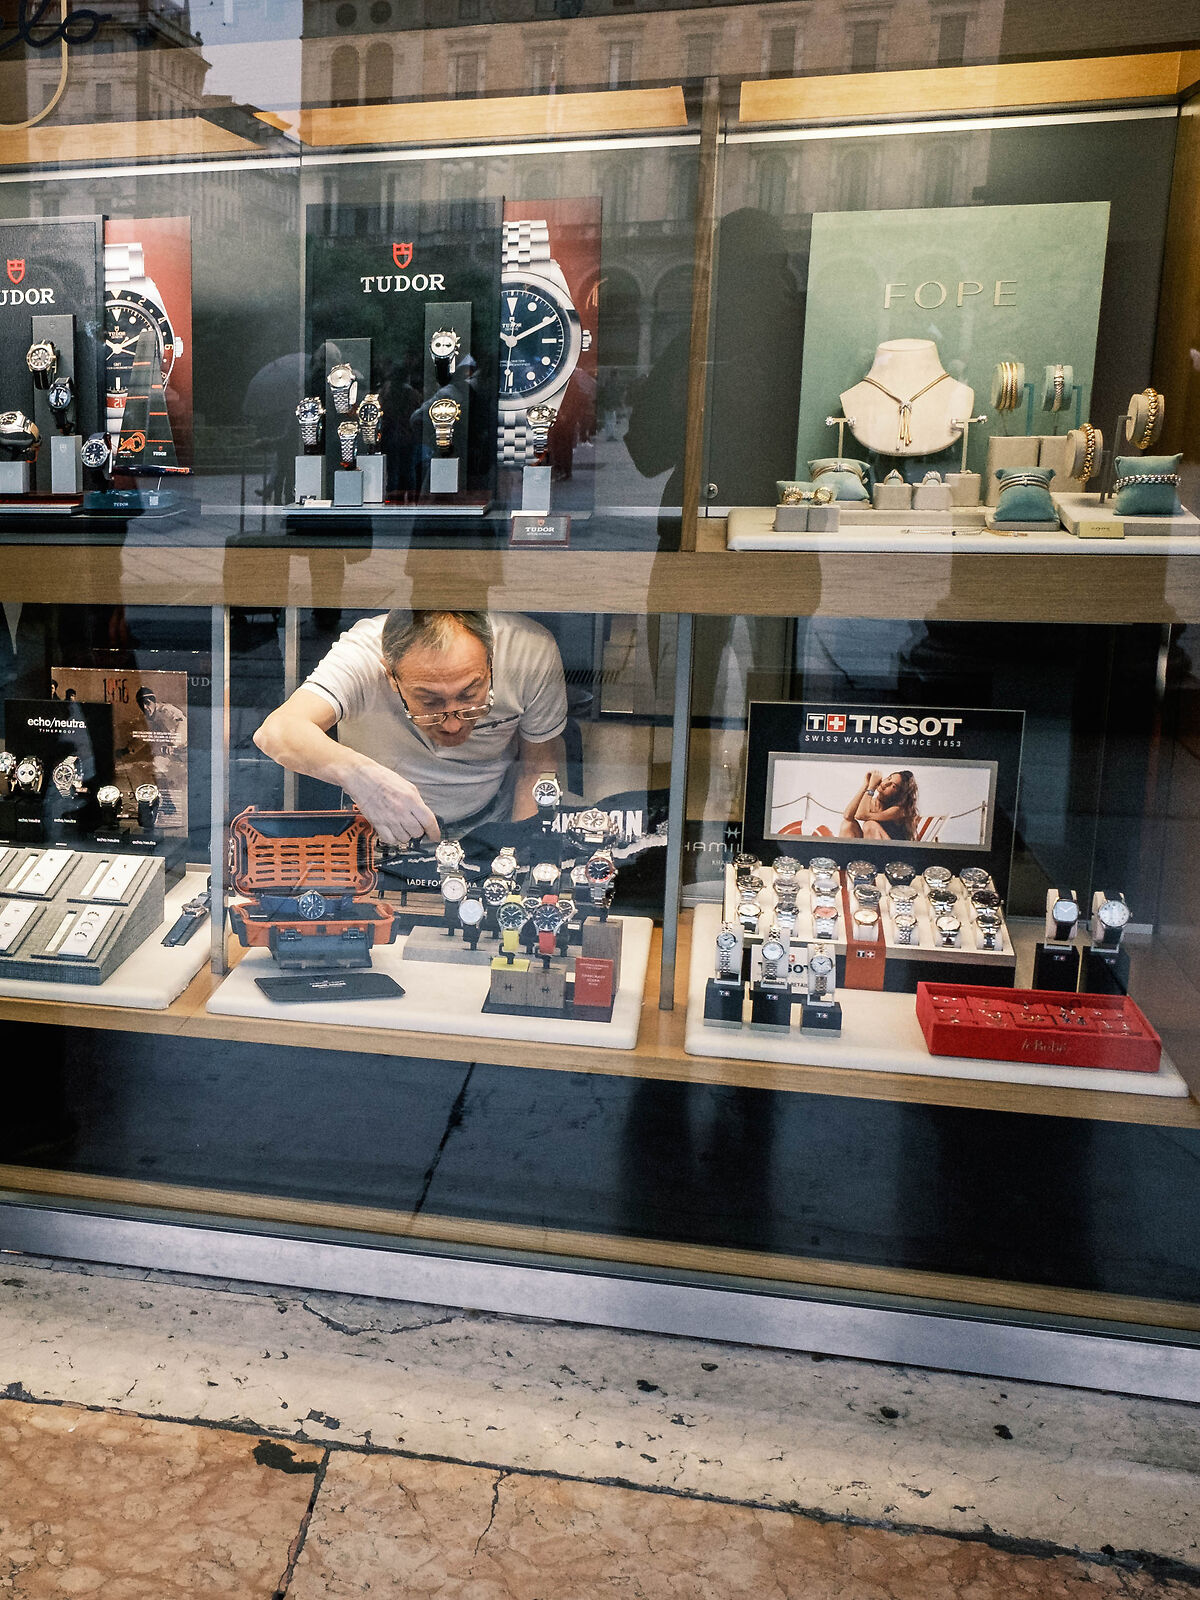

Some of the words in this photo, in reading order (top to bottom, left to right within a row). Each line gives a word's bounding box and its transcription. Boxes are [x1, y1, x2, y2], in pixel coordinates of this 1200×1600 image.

[360, 273, 446, 293] TUDOR
[883, 280, 1017, 310] FOPE
[27, 716, 87, 729] echo/neutra.
[849, 715, 963, 737] TISSOT
[805, 734, 838, 743] SWISS
[844, 736, 893, 745] WATCHES
[899, 738, 931, 746] SINCE
